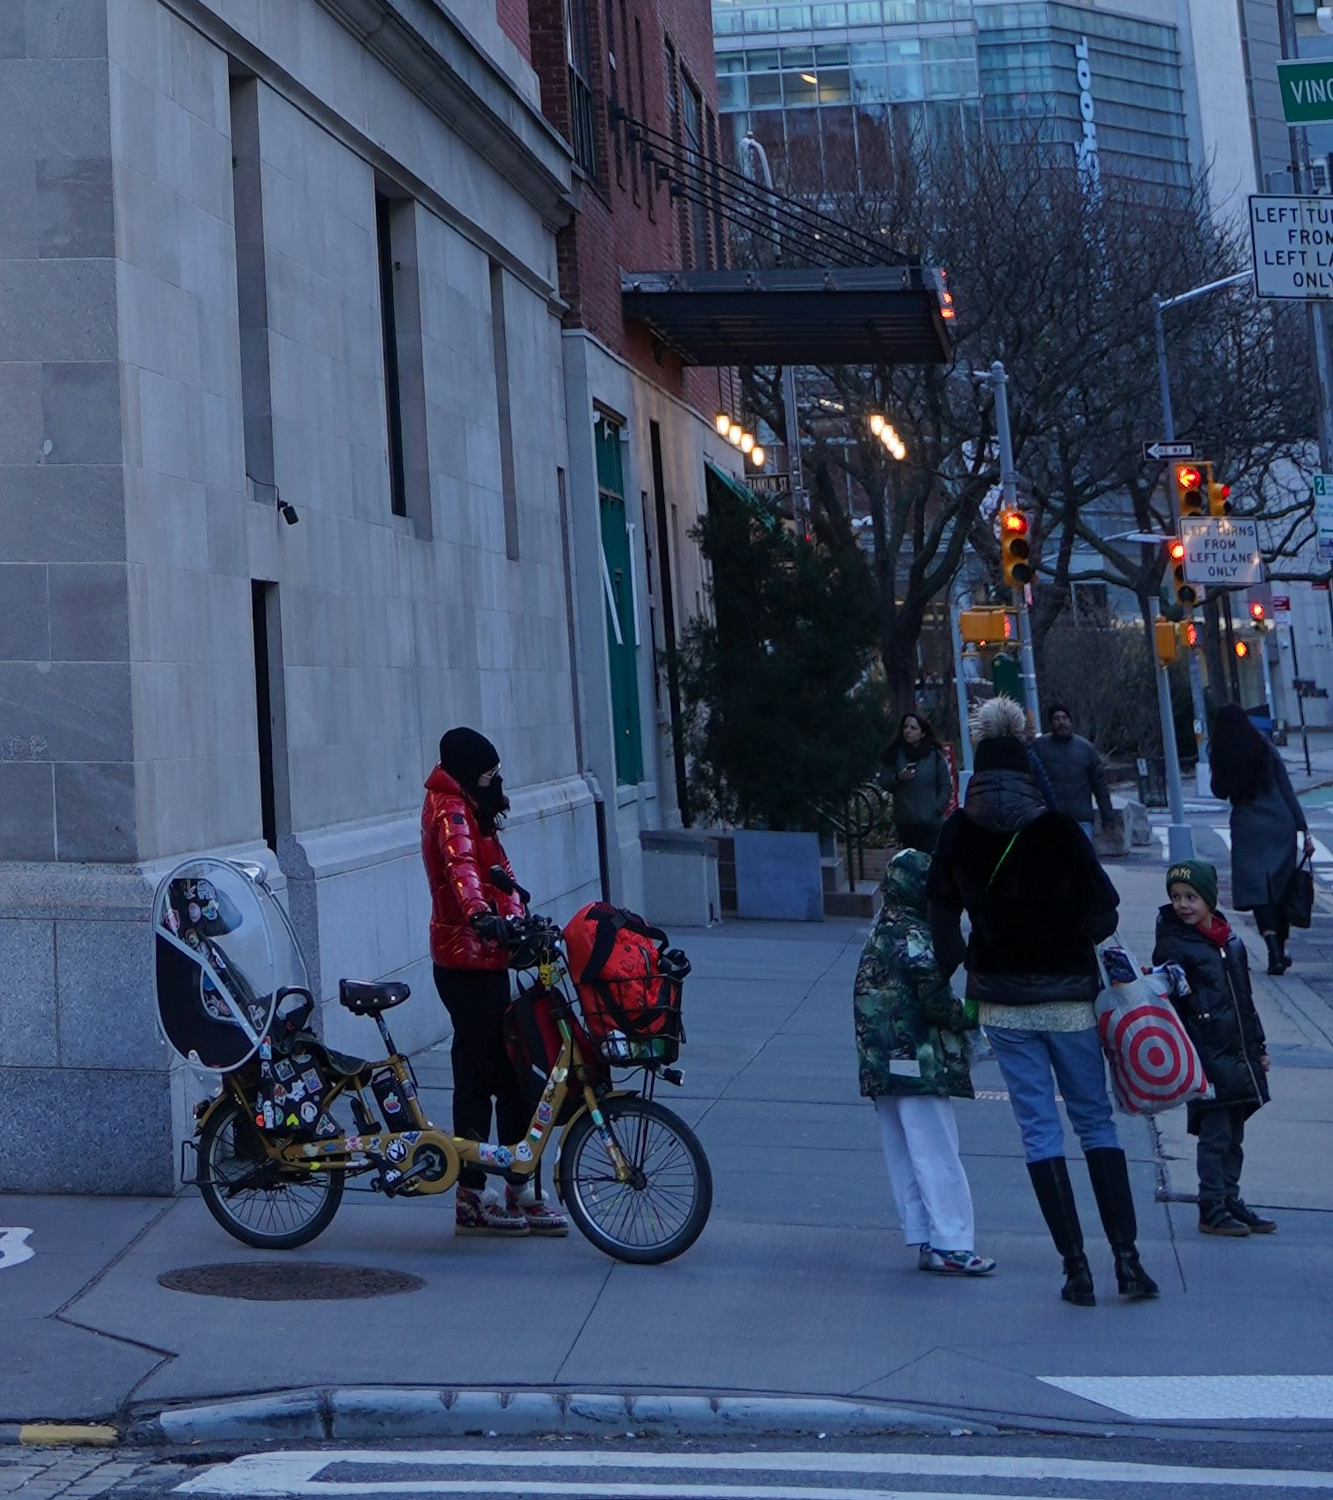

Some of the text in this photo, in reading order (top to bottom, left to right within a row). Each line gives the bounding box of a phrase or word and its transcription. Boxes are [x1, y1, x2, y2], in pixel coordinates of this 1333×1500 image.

[1255, 206, 1333, 224] LEFT TU
[1264, 250, 1307, 266] LEFT
[1183, 525, 1255, 537] LEFT TURNS
[1204, 539, 1237, 550] FROM
[1189, 552, 1254, 564] LEFT LANE
[1207, 566, 1238, 577] ONLY
